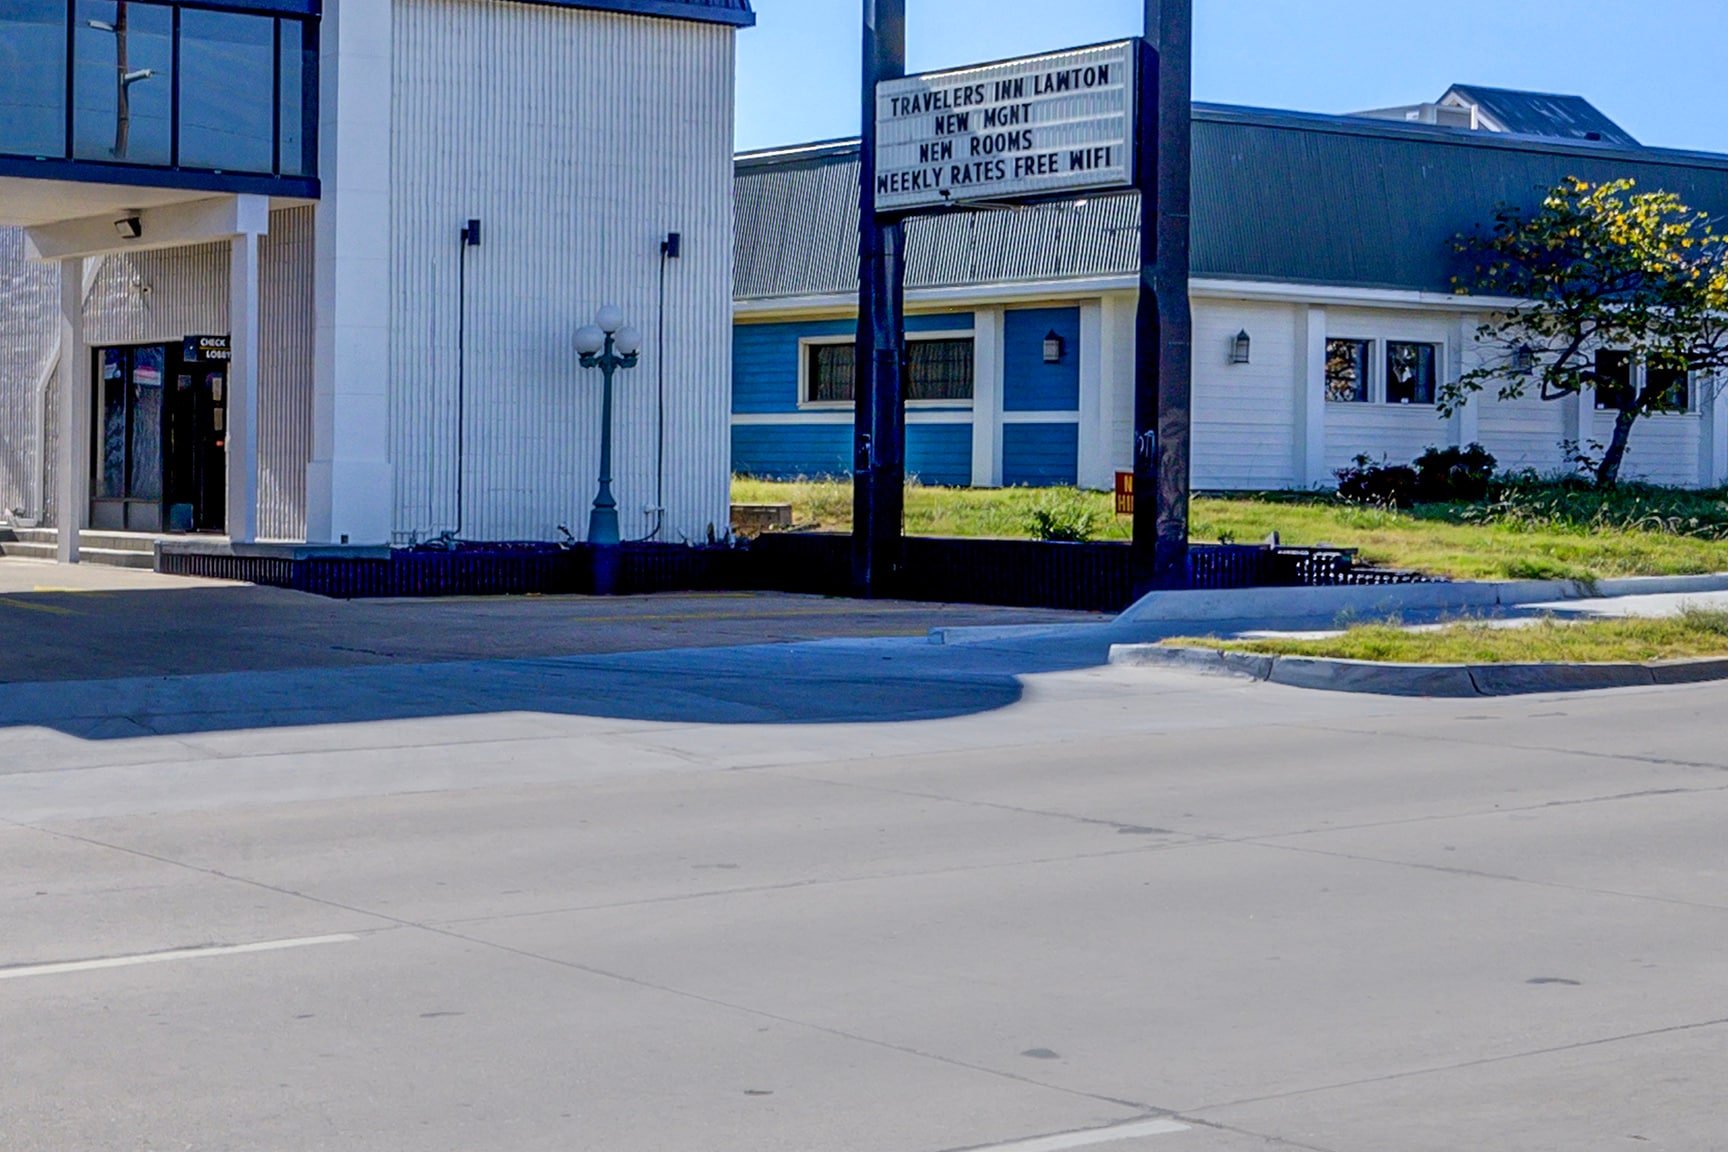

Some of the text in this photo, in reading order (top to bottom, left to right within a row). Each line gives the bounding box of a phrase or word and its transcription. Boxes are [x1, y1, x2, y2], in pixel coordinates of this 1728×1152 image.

[891, 64, 1110, 117] TRAVELERS INN LAWTON
[935, 112, 970, 136] NEW
[920, 130, 1032, 164] NEW ROOMS
[877, 146, 1111, 195] WEEKLY RATES FREE WIFI
[200, 337, 226, 347] CHECK
